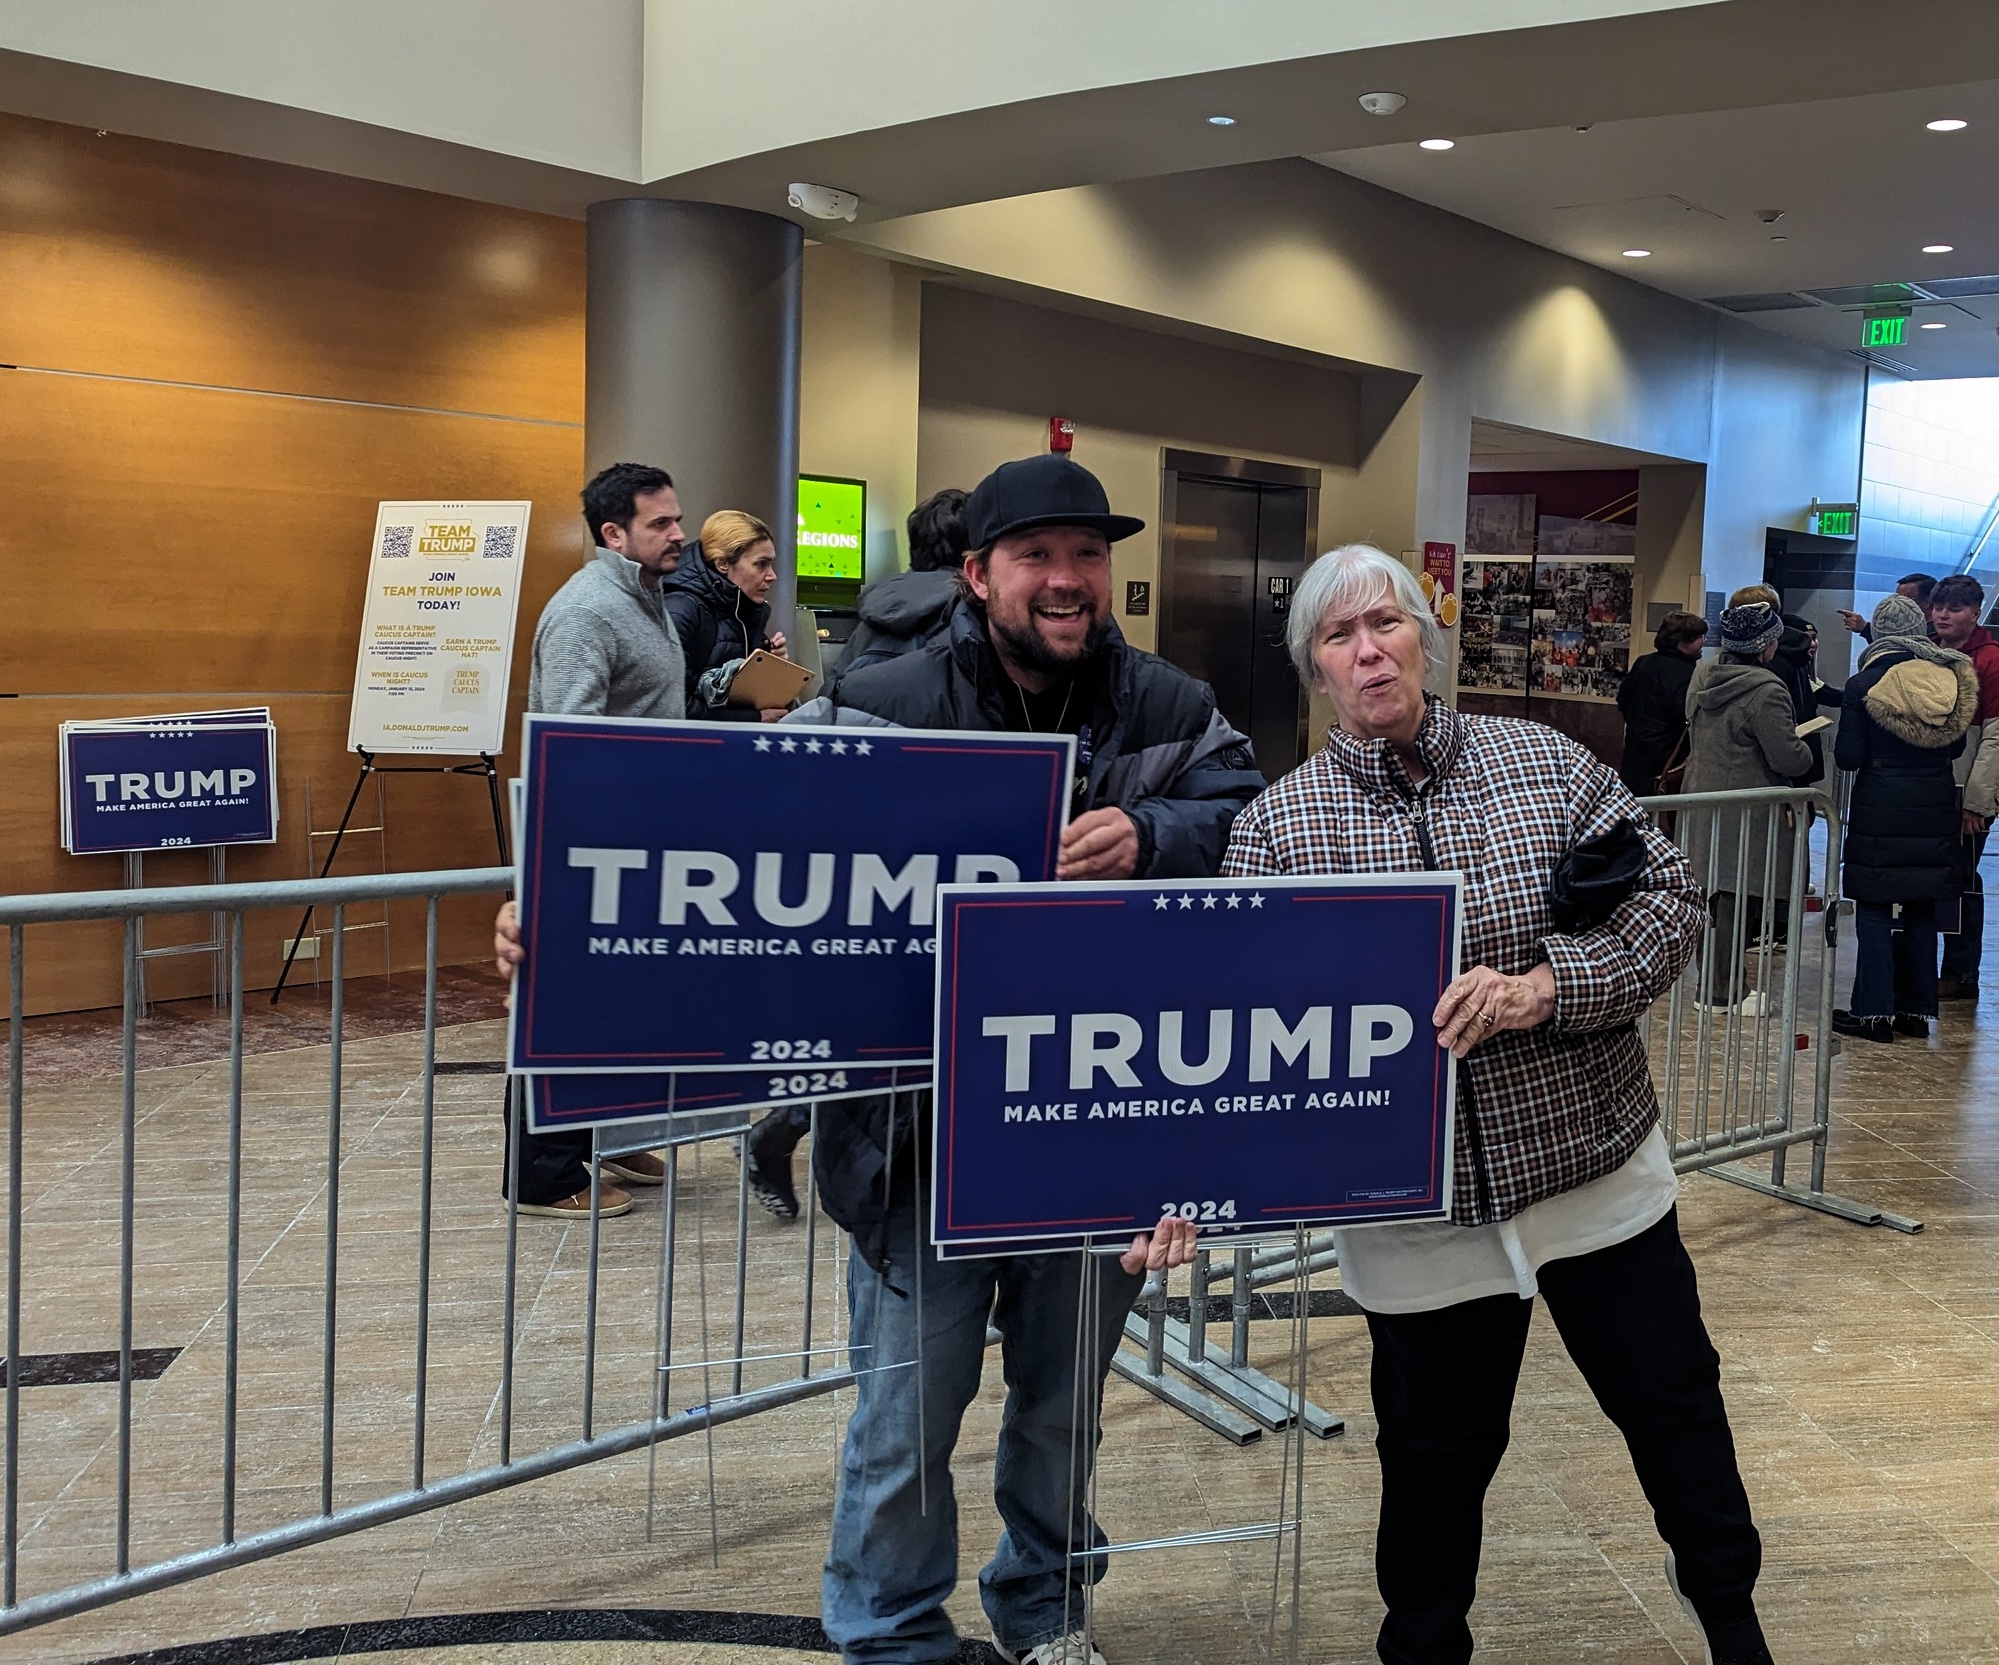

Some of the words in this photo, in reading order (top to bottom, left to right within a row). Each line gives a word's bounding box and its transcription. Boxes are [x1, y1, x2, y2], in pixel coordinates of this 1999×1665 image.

[1870, 318, 1905, 345] EXIT
[1822, 512, 1851, 534] EXIT
[428, 525, 471, 537] TEAM
[421, 538, 474, 551] TRUMP
[428, 572, 456, 582] JOIN
[1441, 568, 1452, 576] YOU
[383, 586, 416, 596] TEAM
[420, 586, 463, 597] TRUMP
[465, 586, 502, 597] IOWA
[1271, 577, 1284, 594] CAR
[1286, 578, 1289, 594] 1
[417, 600, 461, 610] TODAY!
[456, 670, 480, 678] TRUMP
[453, 678, 480, 686] CAUCUS
[451, 686, 480, 694] CAPTAIN
[382, 724, 469, 732] IA.DONALDJTRUMP.COM
[85, 768, 257, 802] TRUMP
[96, 804, 126, 813] MAKE
[129, 801, 176, 811] AMERICA
[178, 800, 212, 808] GREAT
[214, 798, 249, 806] AGAIN!
[160, 836, 192, 846] 2024
[588, 936, 668, 956] MAKE
[678, 937, 801, 956] AMERICA
[810, 937, 897, 956] GREAT
[750, 1038, 833, 1061] 2024
[982, 1003, 1415, 1093] TRUMP
[768, 1069, 849, 1098] 2024
[1003, 1102, 1078, 1123] MAKE
[1087, 1098, 1205, 1119] AMERICA
[1214, 1093, 1297, 1115] GREAT
[1303, 1089, 1391, 1110] AGAIN!
[1160, 1199, 1237, 1222] 2024
